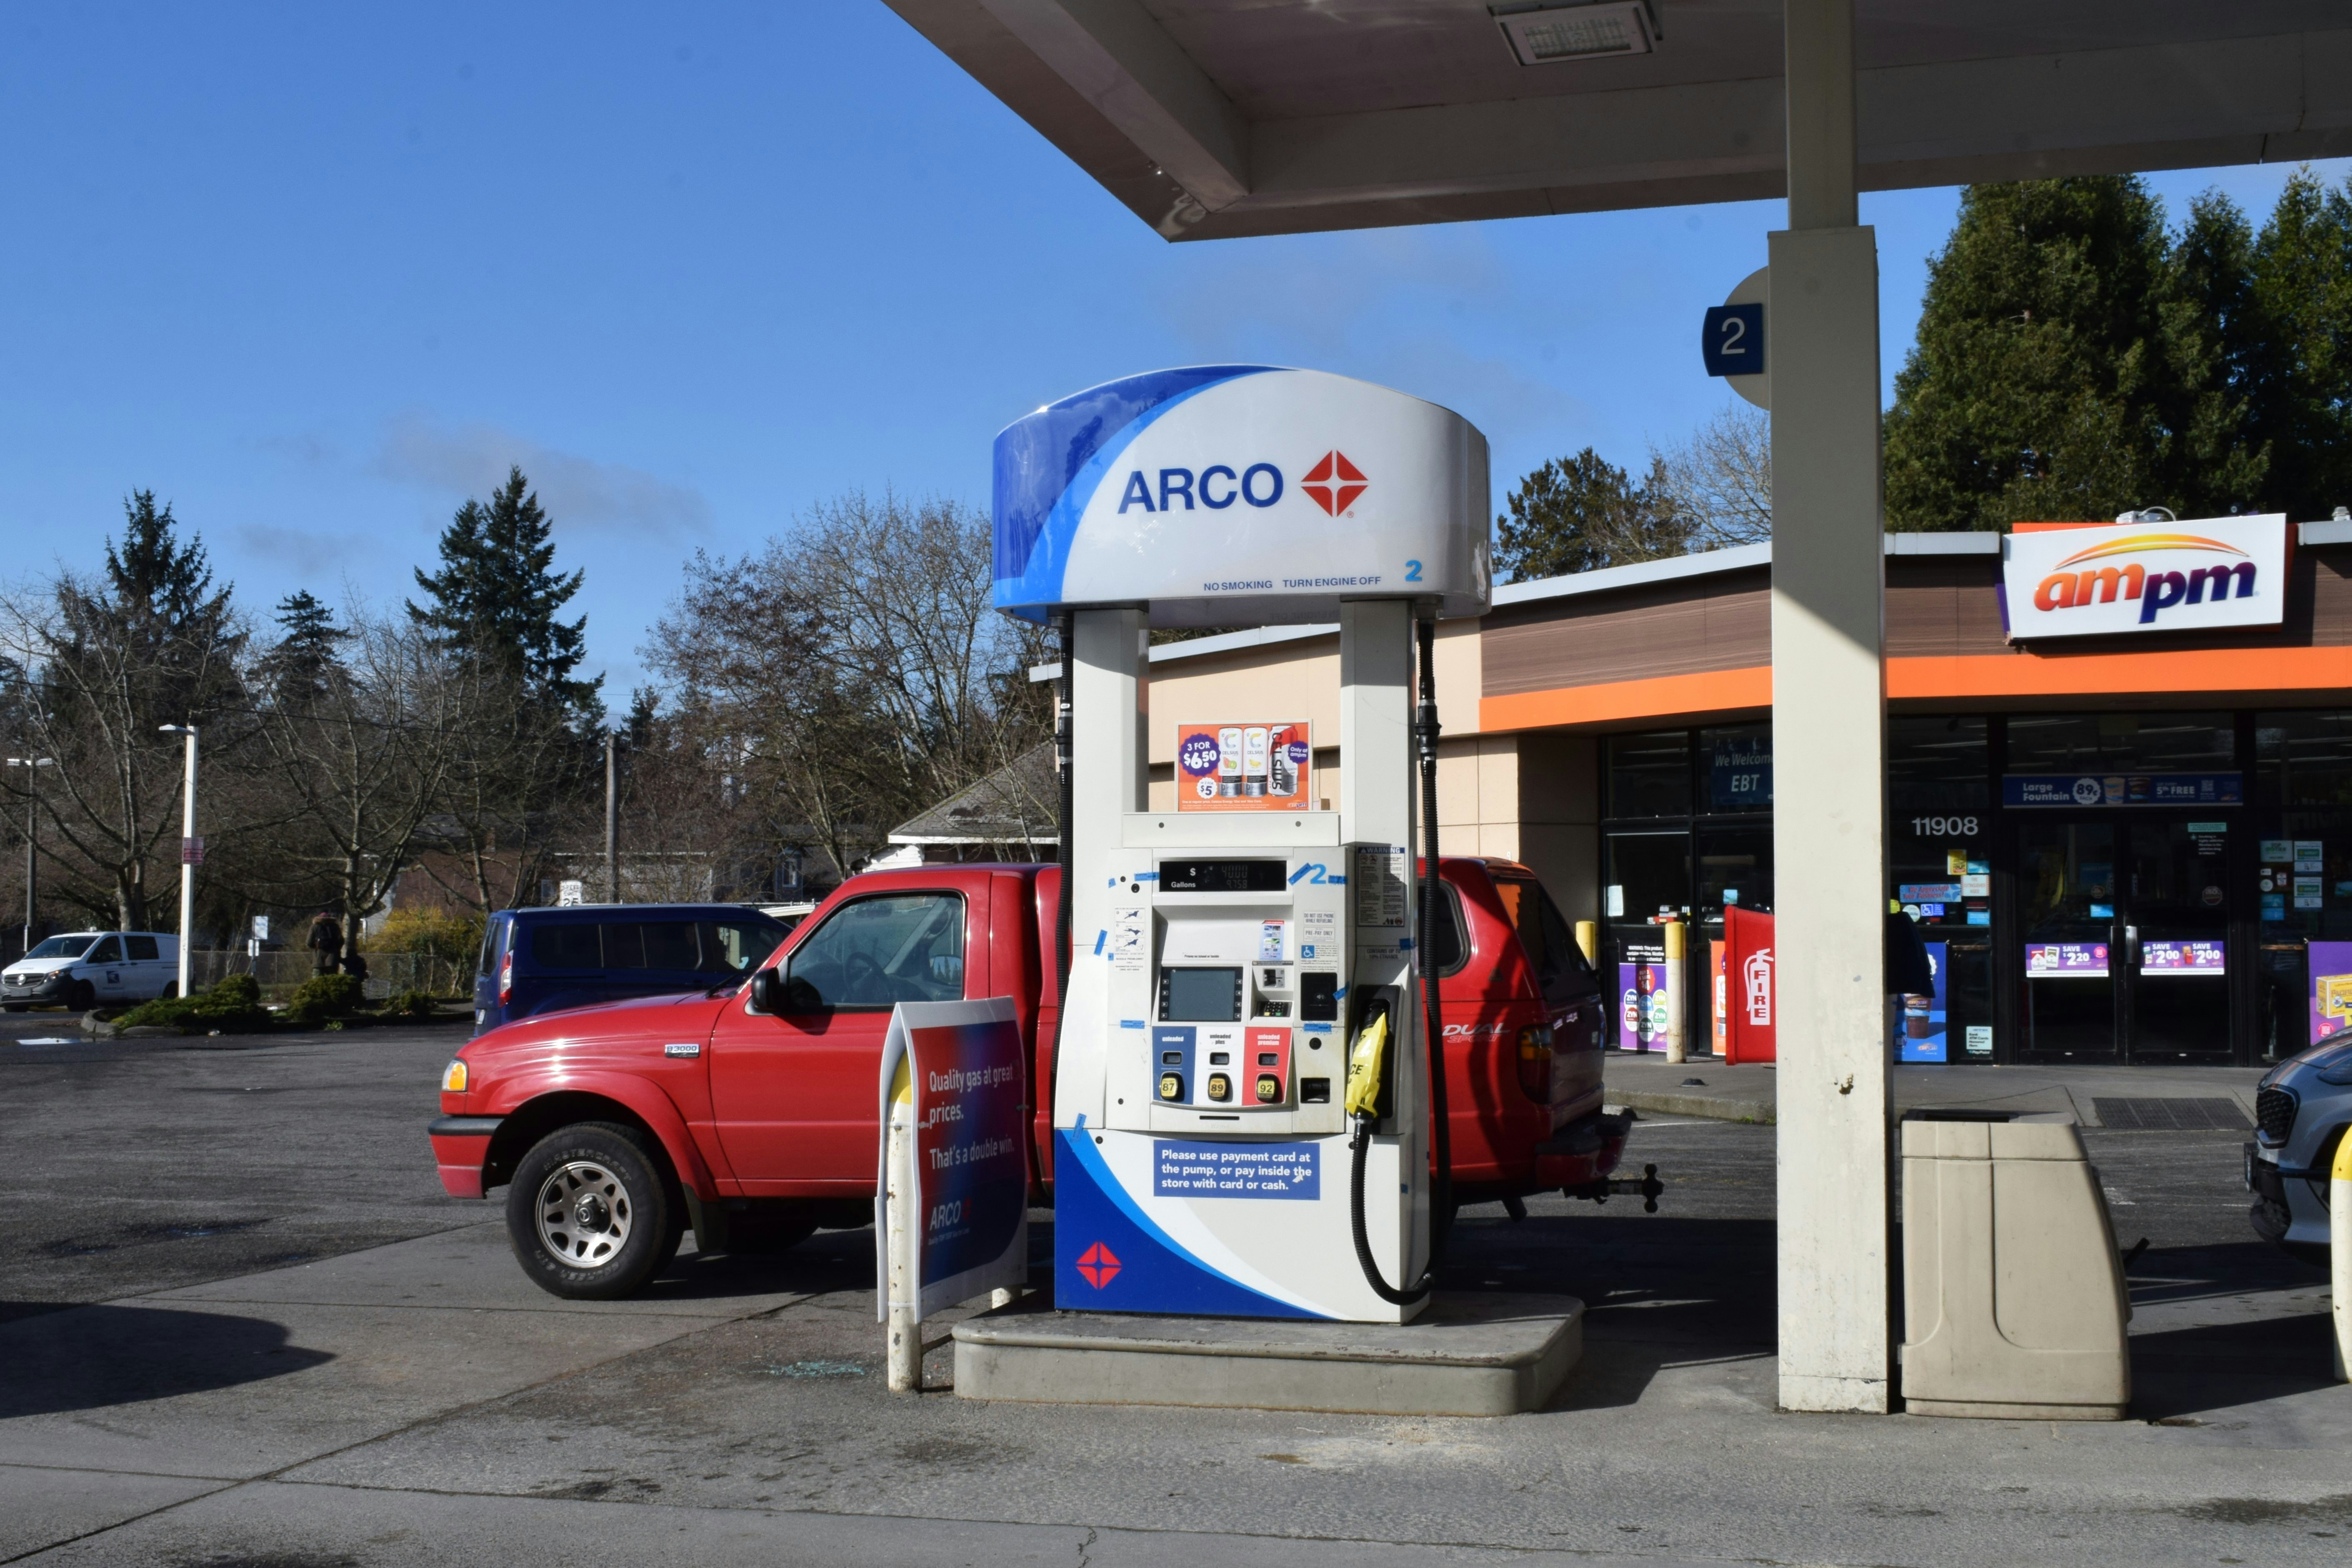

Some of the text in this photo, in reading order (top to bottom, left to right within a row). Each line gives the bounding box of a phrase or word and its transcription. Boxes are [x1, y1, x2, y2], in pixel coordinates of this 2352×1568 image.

[1721, 317, 1745, 355] 2
[1117, 462, 1284, 514] ARCO
[1405, 560, 1422, 582] 2
[1204, 576, 1381, 591] NO SMOKING TURN ENGINE OFF
[2034, 561, 2257, 624] ampm
[1194, 741, 1210, 750] FOR
[1183, 750, 1217, 769] $6.50
[1272, 732, 1282, 789] CELSIUS
[1715, 754, 1730, 767] We
[1200, 785, 1212, 796] $5
[1731, 774, 1760, 792] EBT
[2023, 783, 2053, 793] Large
[2170, 786, 2195, 795] FREE
[2023, 792, 2070, 801] Fountain
[1911, 817, 1979, 836] 11908
[1310, 863, 1327, 884] 2
[1753, 970, 1766, 1018] FIRE
[1442, 1022, 1511, 1036] DUAL
[1447, 1034, 1501, 1043] SPORT
[929, 1063, 1013, 1094] Quality gas at great
[1162, 1083, 1175, 1092] 87
[1260, 1084, 1272, 1093] 92
[929, 1101, 964, 1130] prices.
[929, 1134, 1015, 1170] That's a double win.
[1162, 1149, 1196, 1160] Please
[1221, 1152, 1269, 1163] payment
[1272, 1152, 1296, 1162] card
[1299, 1153, 1310, 1162] at
[1161, 1163, 1180, 1173] the
[1182, 1166, 1217, 1176] pump,
[1235, 1167, 1255, 1178] pay
[1258, 1165, 1290, 1176] inside
[1293, 1166, 1312, 1176] the
[1161, 1179, 1190, 1188] store
[1193, 1179, 1217, 1188] with
[1220, 1179, 1243, 1189] card
[1261, 1180, 1289, 1190] cash.
[929, 1200, 961, 1231] ARCO
